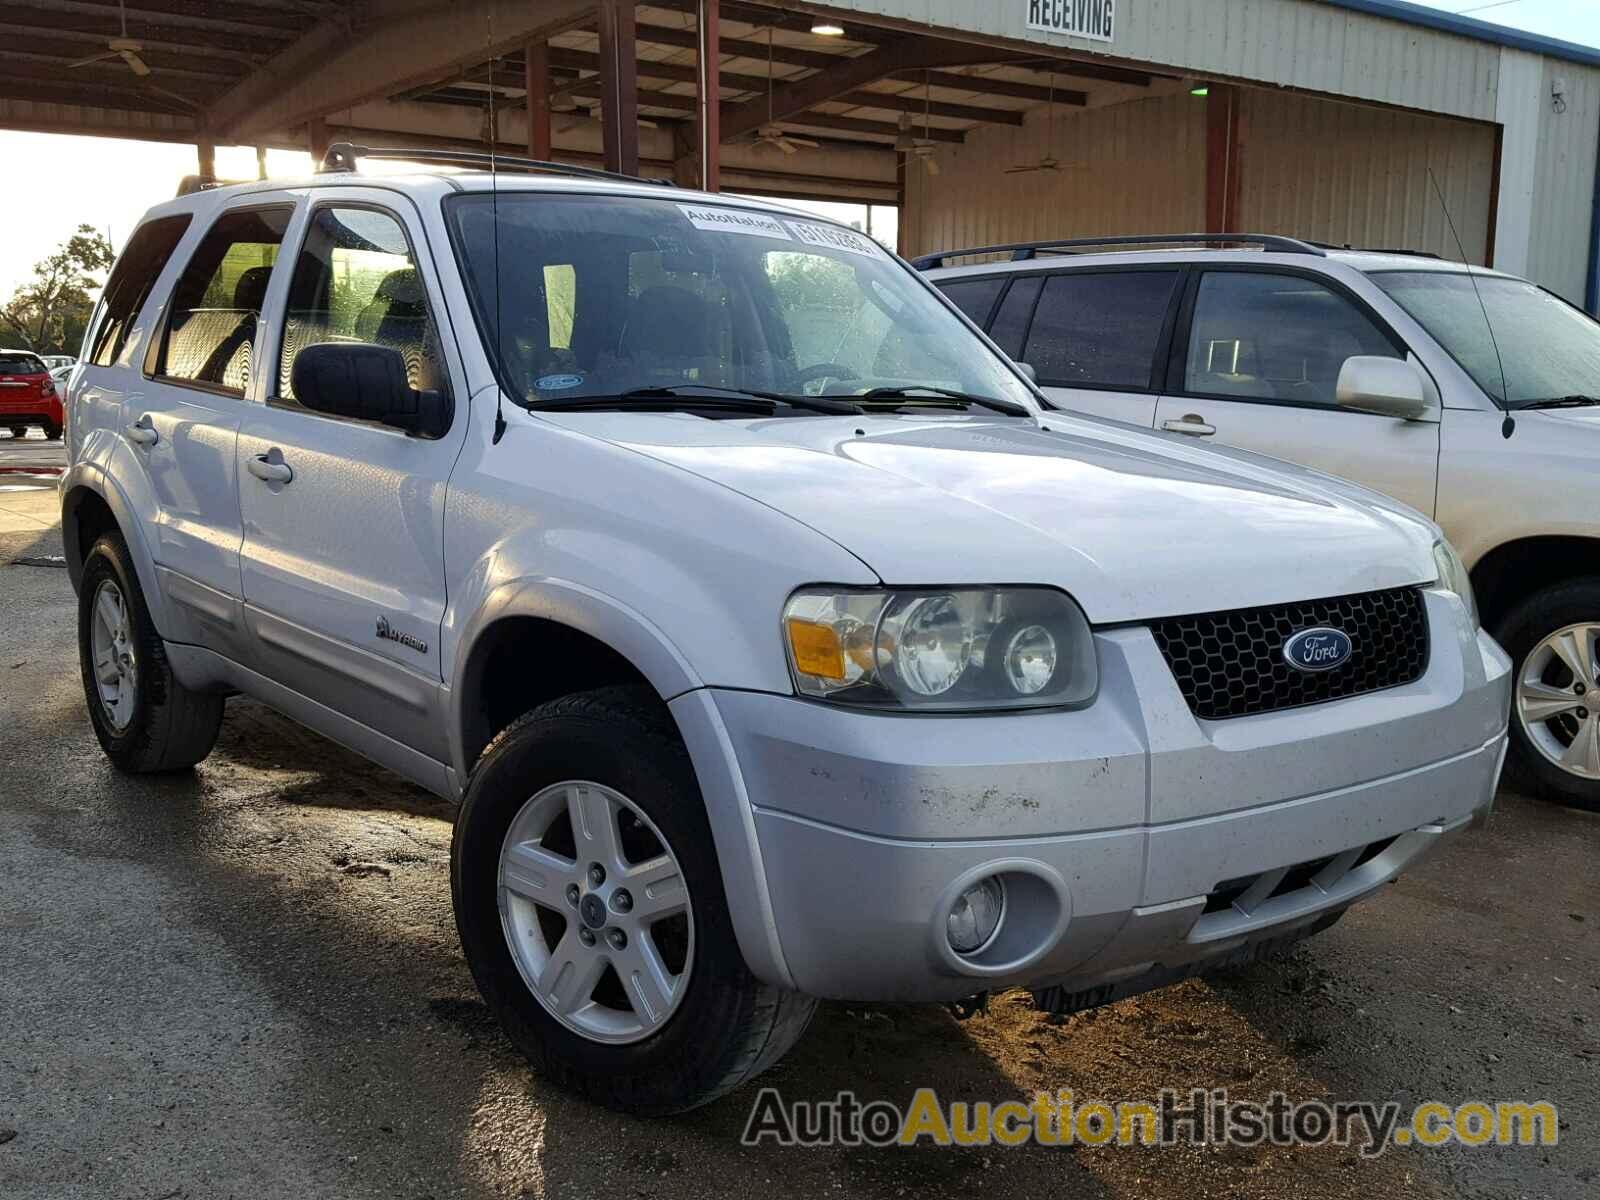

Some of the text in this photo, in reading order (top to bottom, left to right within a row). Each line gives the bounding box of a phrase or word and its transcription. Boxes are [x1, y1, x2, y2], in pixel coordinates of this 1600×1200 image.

[1029, 0, 1112, 37] RECEIVING
[687, 210, 782, 231] AutoNation
[1303, 635, 1340, 662] Ford
